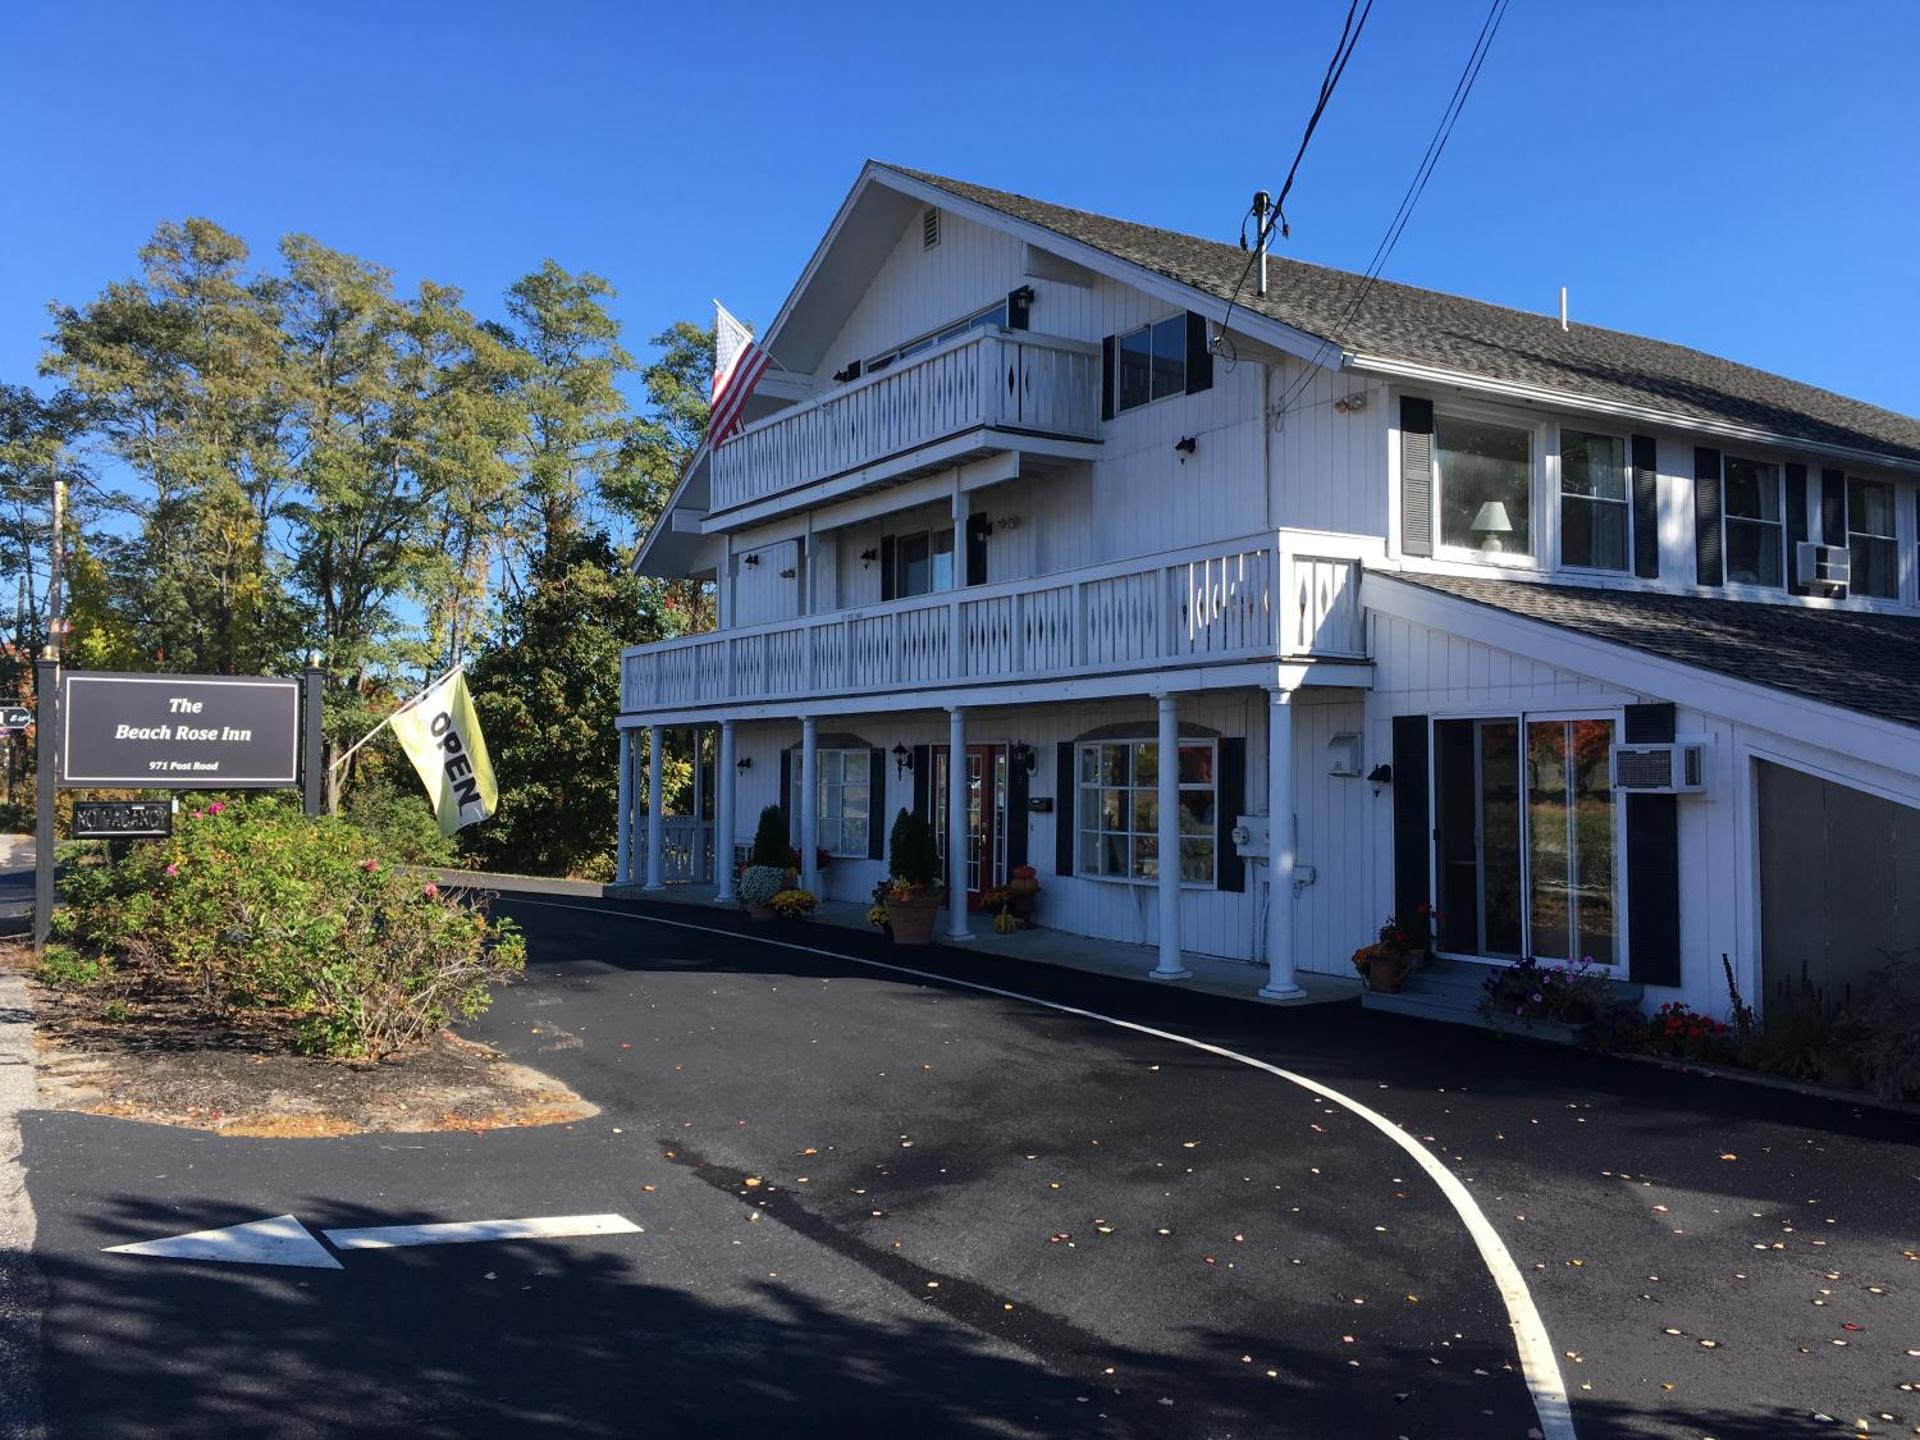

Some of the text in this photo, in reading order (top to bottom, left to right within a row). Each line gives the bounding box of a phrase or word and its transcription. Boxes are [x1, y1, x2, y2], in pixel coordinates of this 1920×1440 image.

[169, 697, 204, 714] The
[115, 724, 252, 742] Beach Rose Inn
[148, 760, 219, 771] 971 Post Road
[430, 711, 482, 817] OPEN
